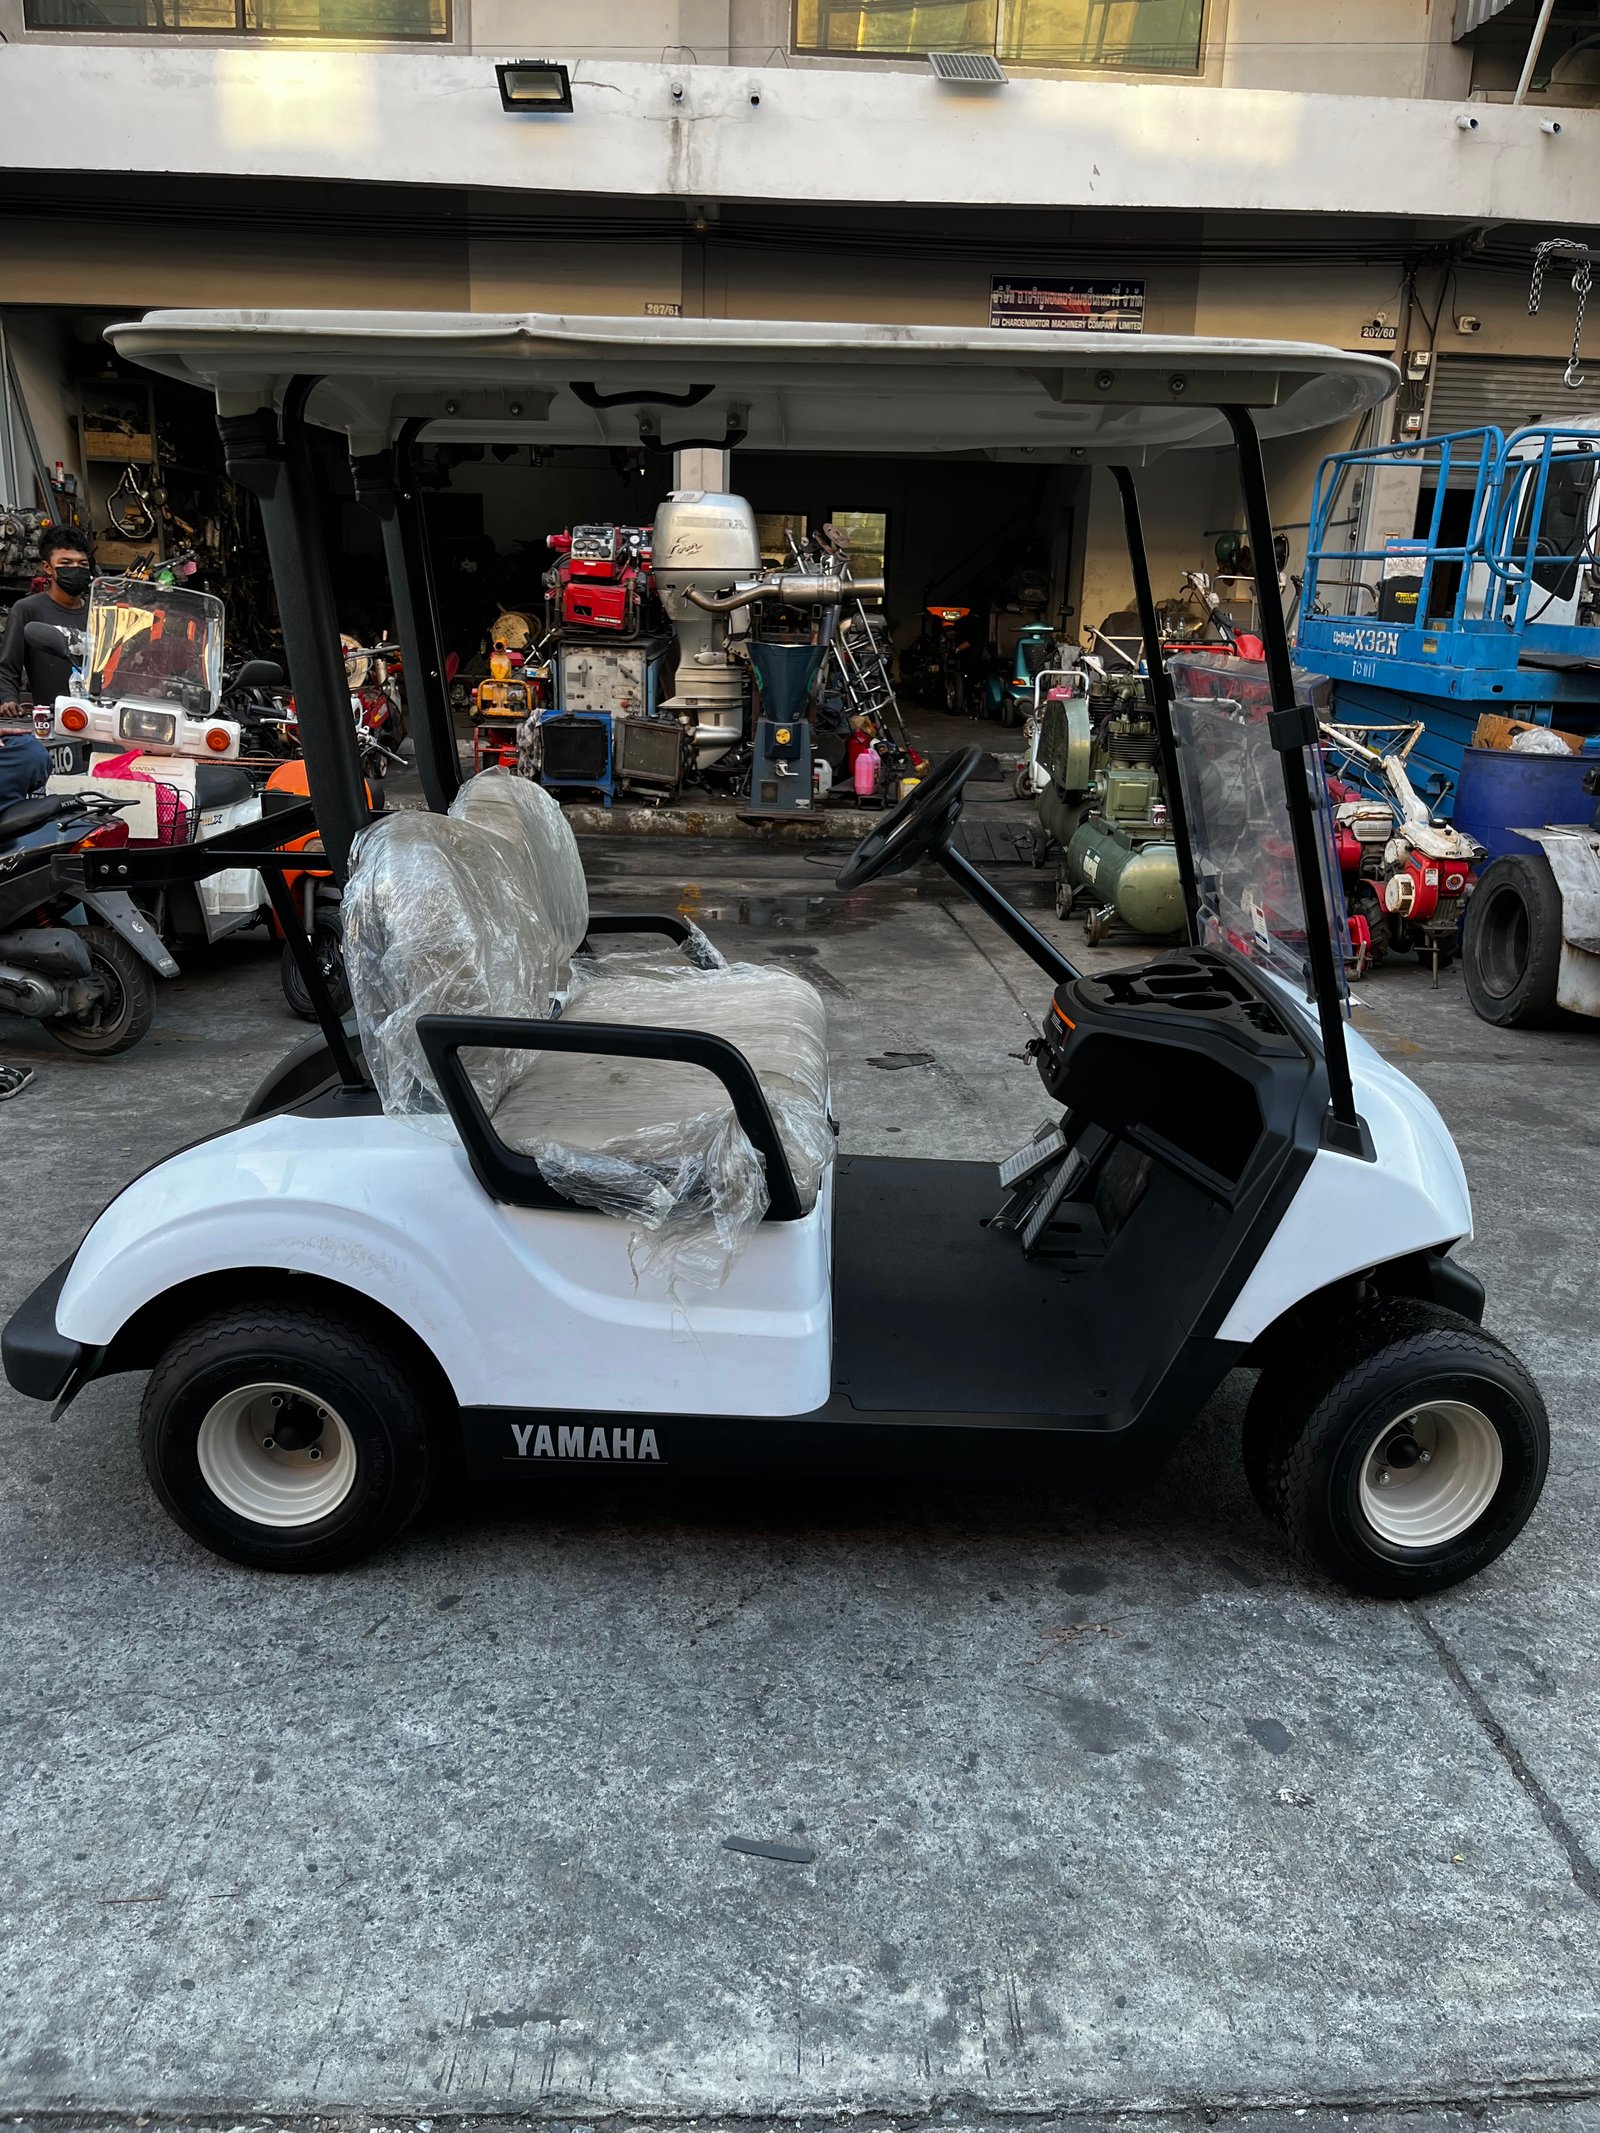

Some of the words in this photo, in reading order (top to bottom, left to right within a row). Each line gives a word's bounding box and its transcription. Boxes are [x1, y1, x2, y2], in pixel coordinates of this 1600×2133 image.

[647, 304, 679, 316] 207/61
[992, 318, 1000, 327] AU
[1051, 320, 1086, 329] MACHINERY
[1087, 320, 1117, 329] COMPANY
[1119, 322, 1142, 330] LIMITED
[1362, 327, 1395, 338] 207/60
[1354, 629, 1399, 656] X32N
[511, 1424, 660, 1460] YAMAHA
